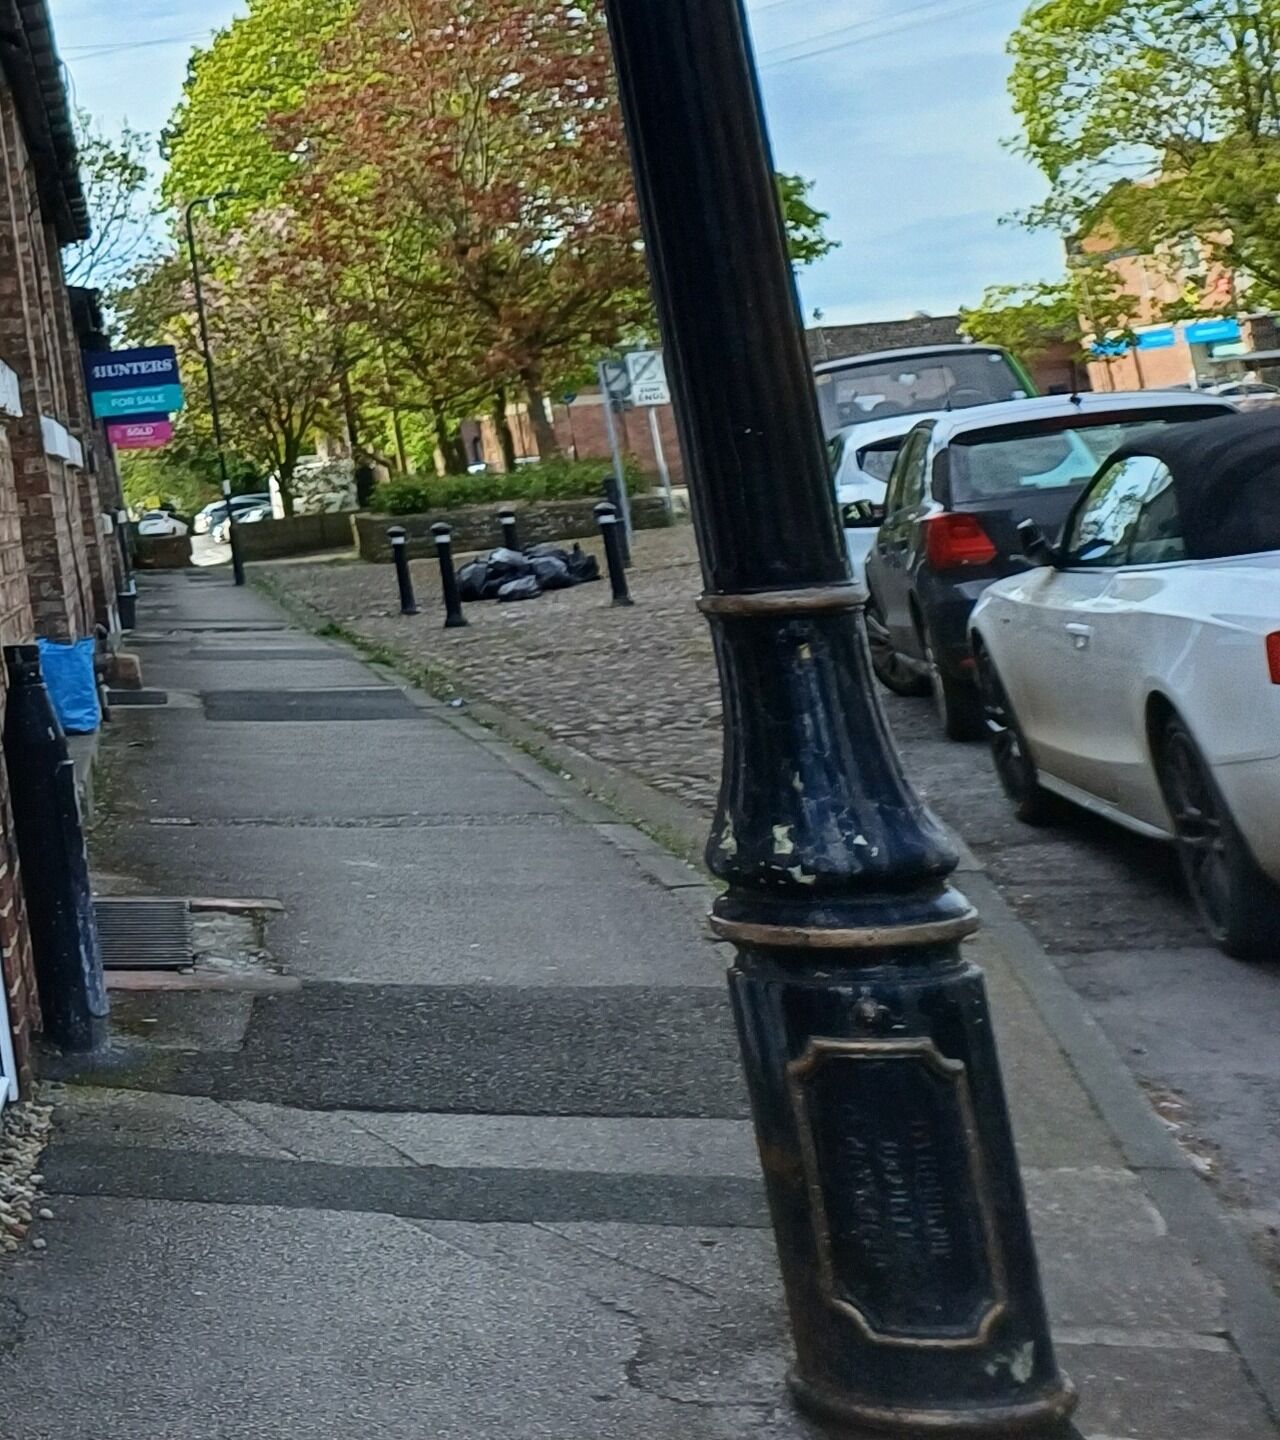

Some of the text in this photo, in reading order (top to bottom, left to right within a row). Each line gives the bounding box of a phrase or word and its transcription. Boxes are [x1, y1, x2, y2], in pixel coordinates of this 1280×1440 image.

[93, 359, 173, 378] HUNTERS
[110, 393, 166, 408] FOR SALE
[126, 426, 154, 437] SOLD
